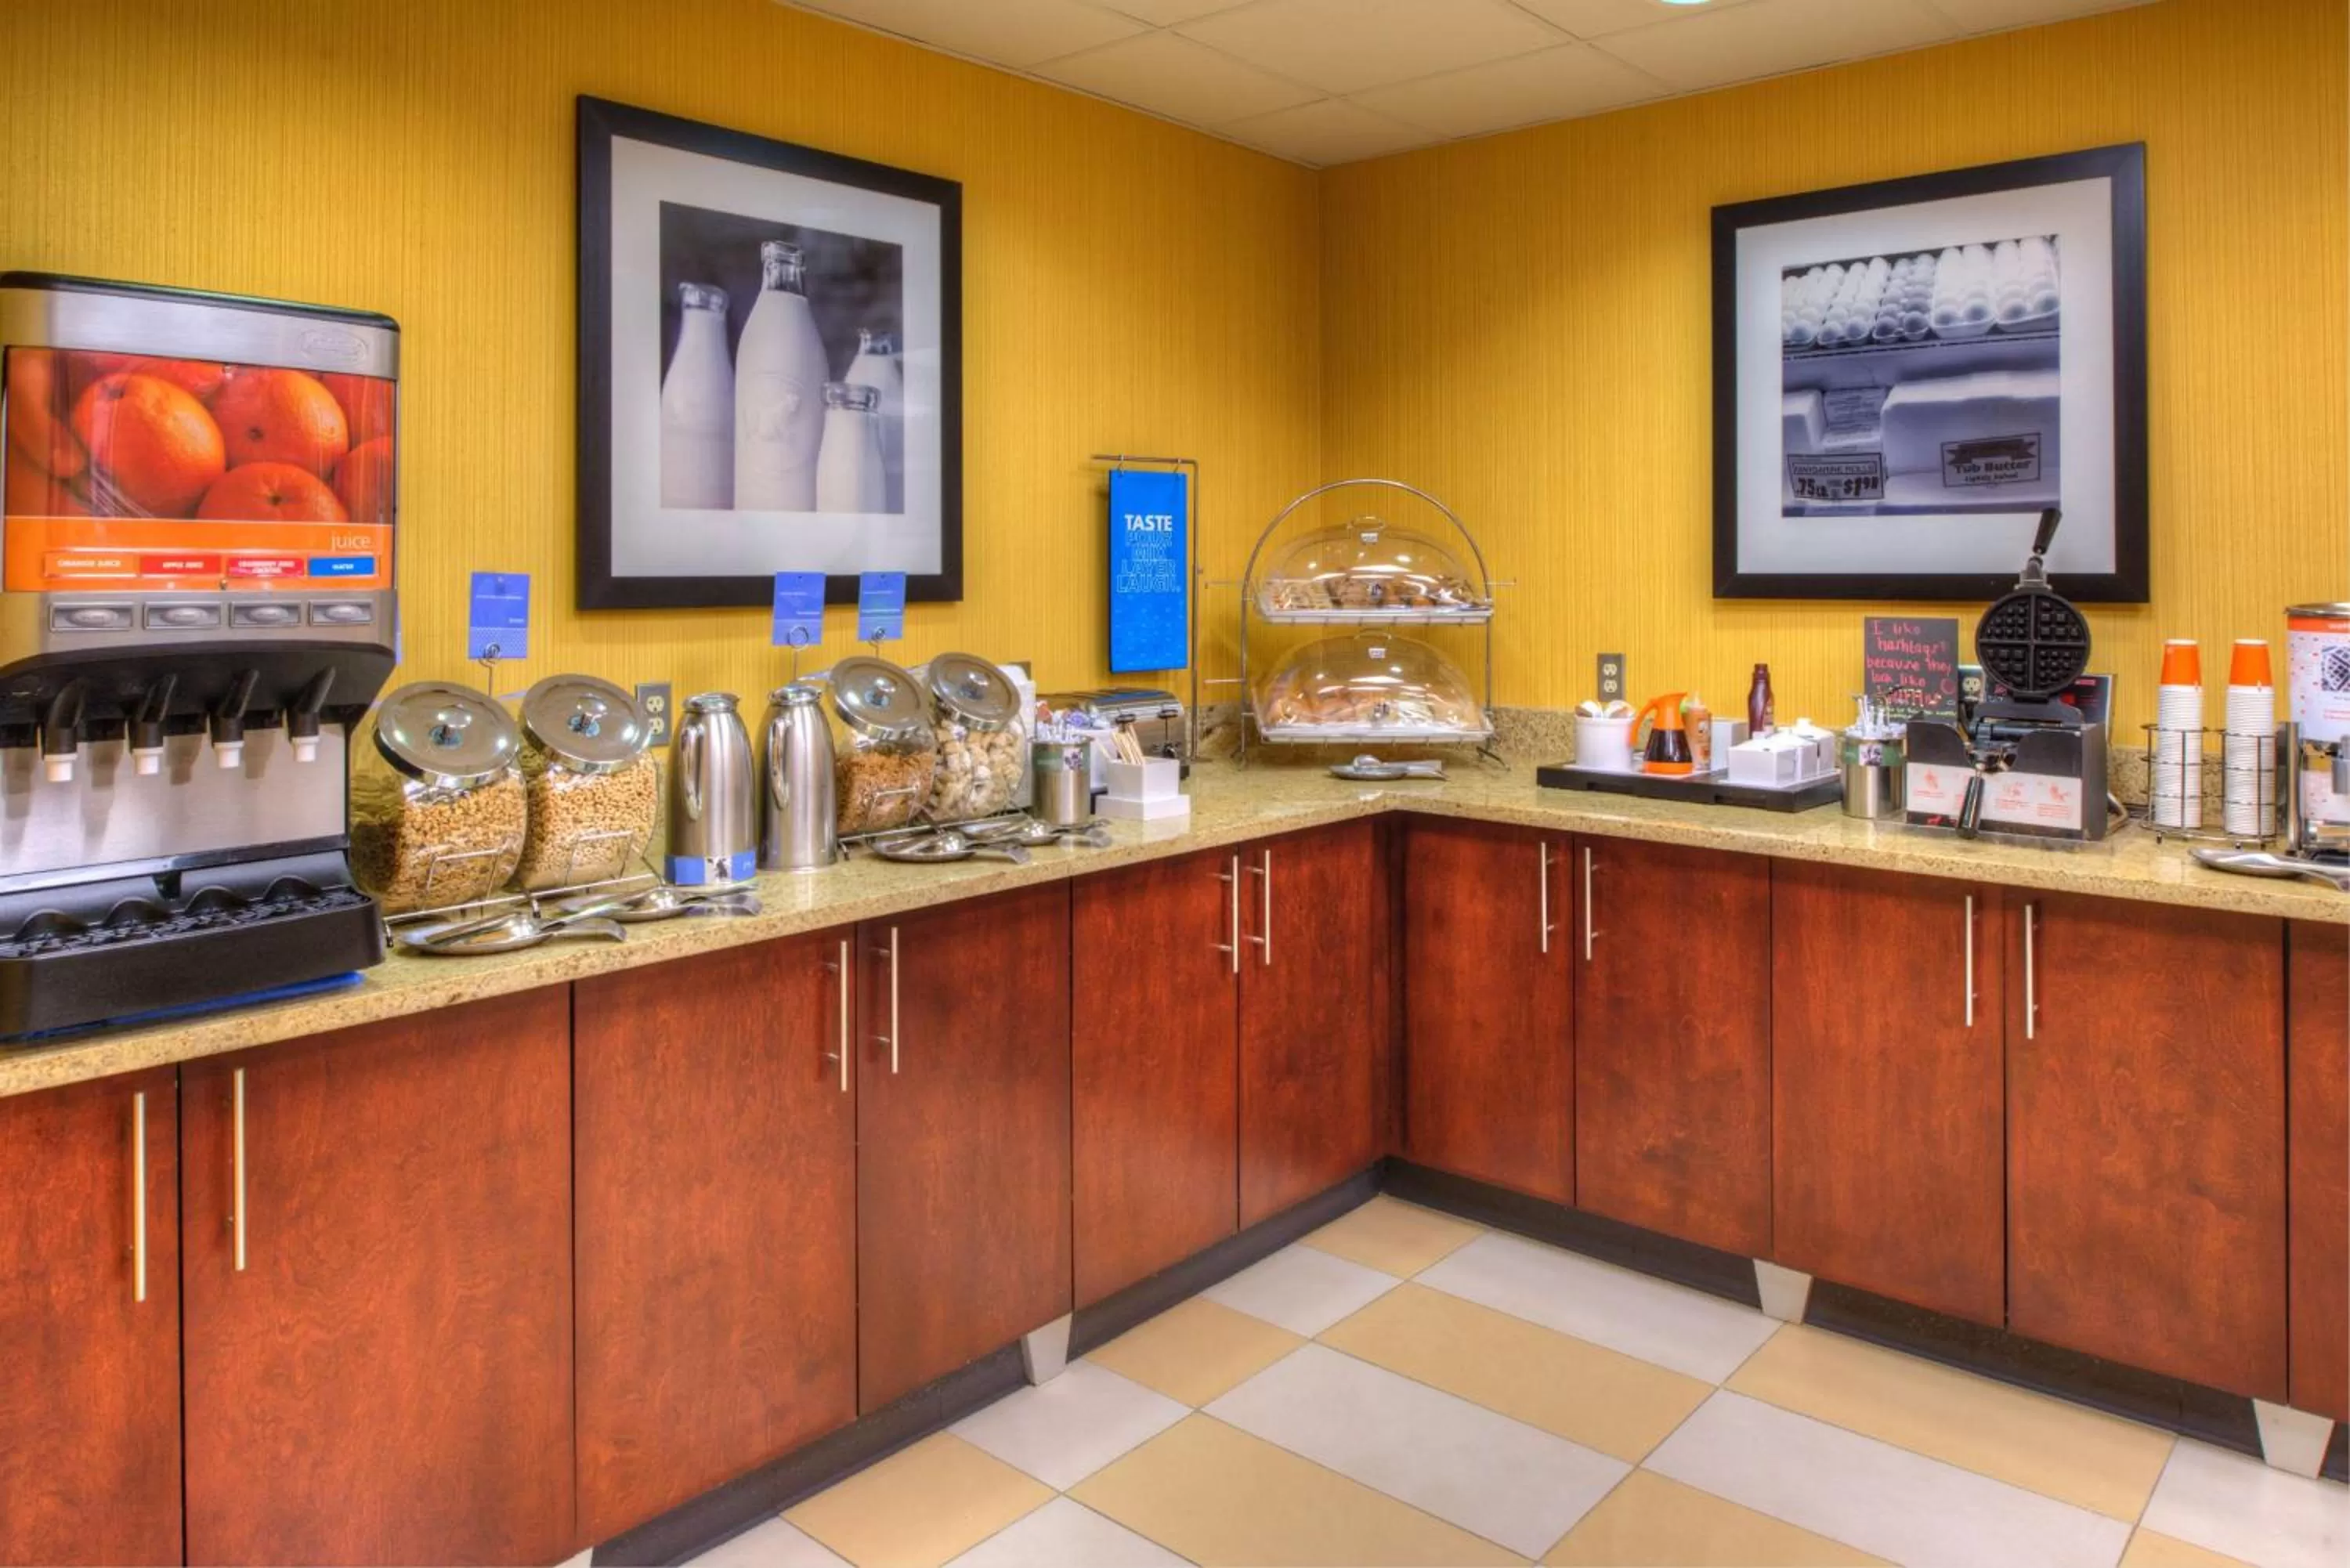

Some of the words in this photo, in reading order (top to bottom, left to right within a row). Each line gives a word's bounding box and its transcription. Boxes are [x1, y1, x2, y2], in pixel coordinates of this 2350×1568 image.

[1124, 514, 1173, 532] TASTE
[330, 530, 371, 552] juice
[1866, 655, 1922, 671] because
